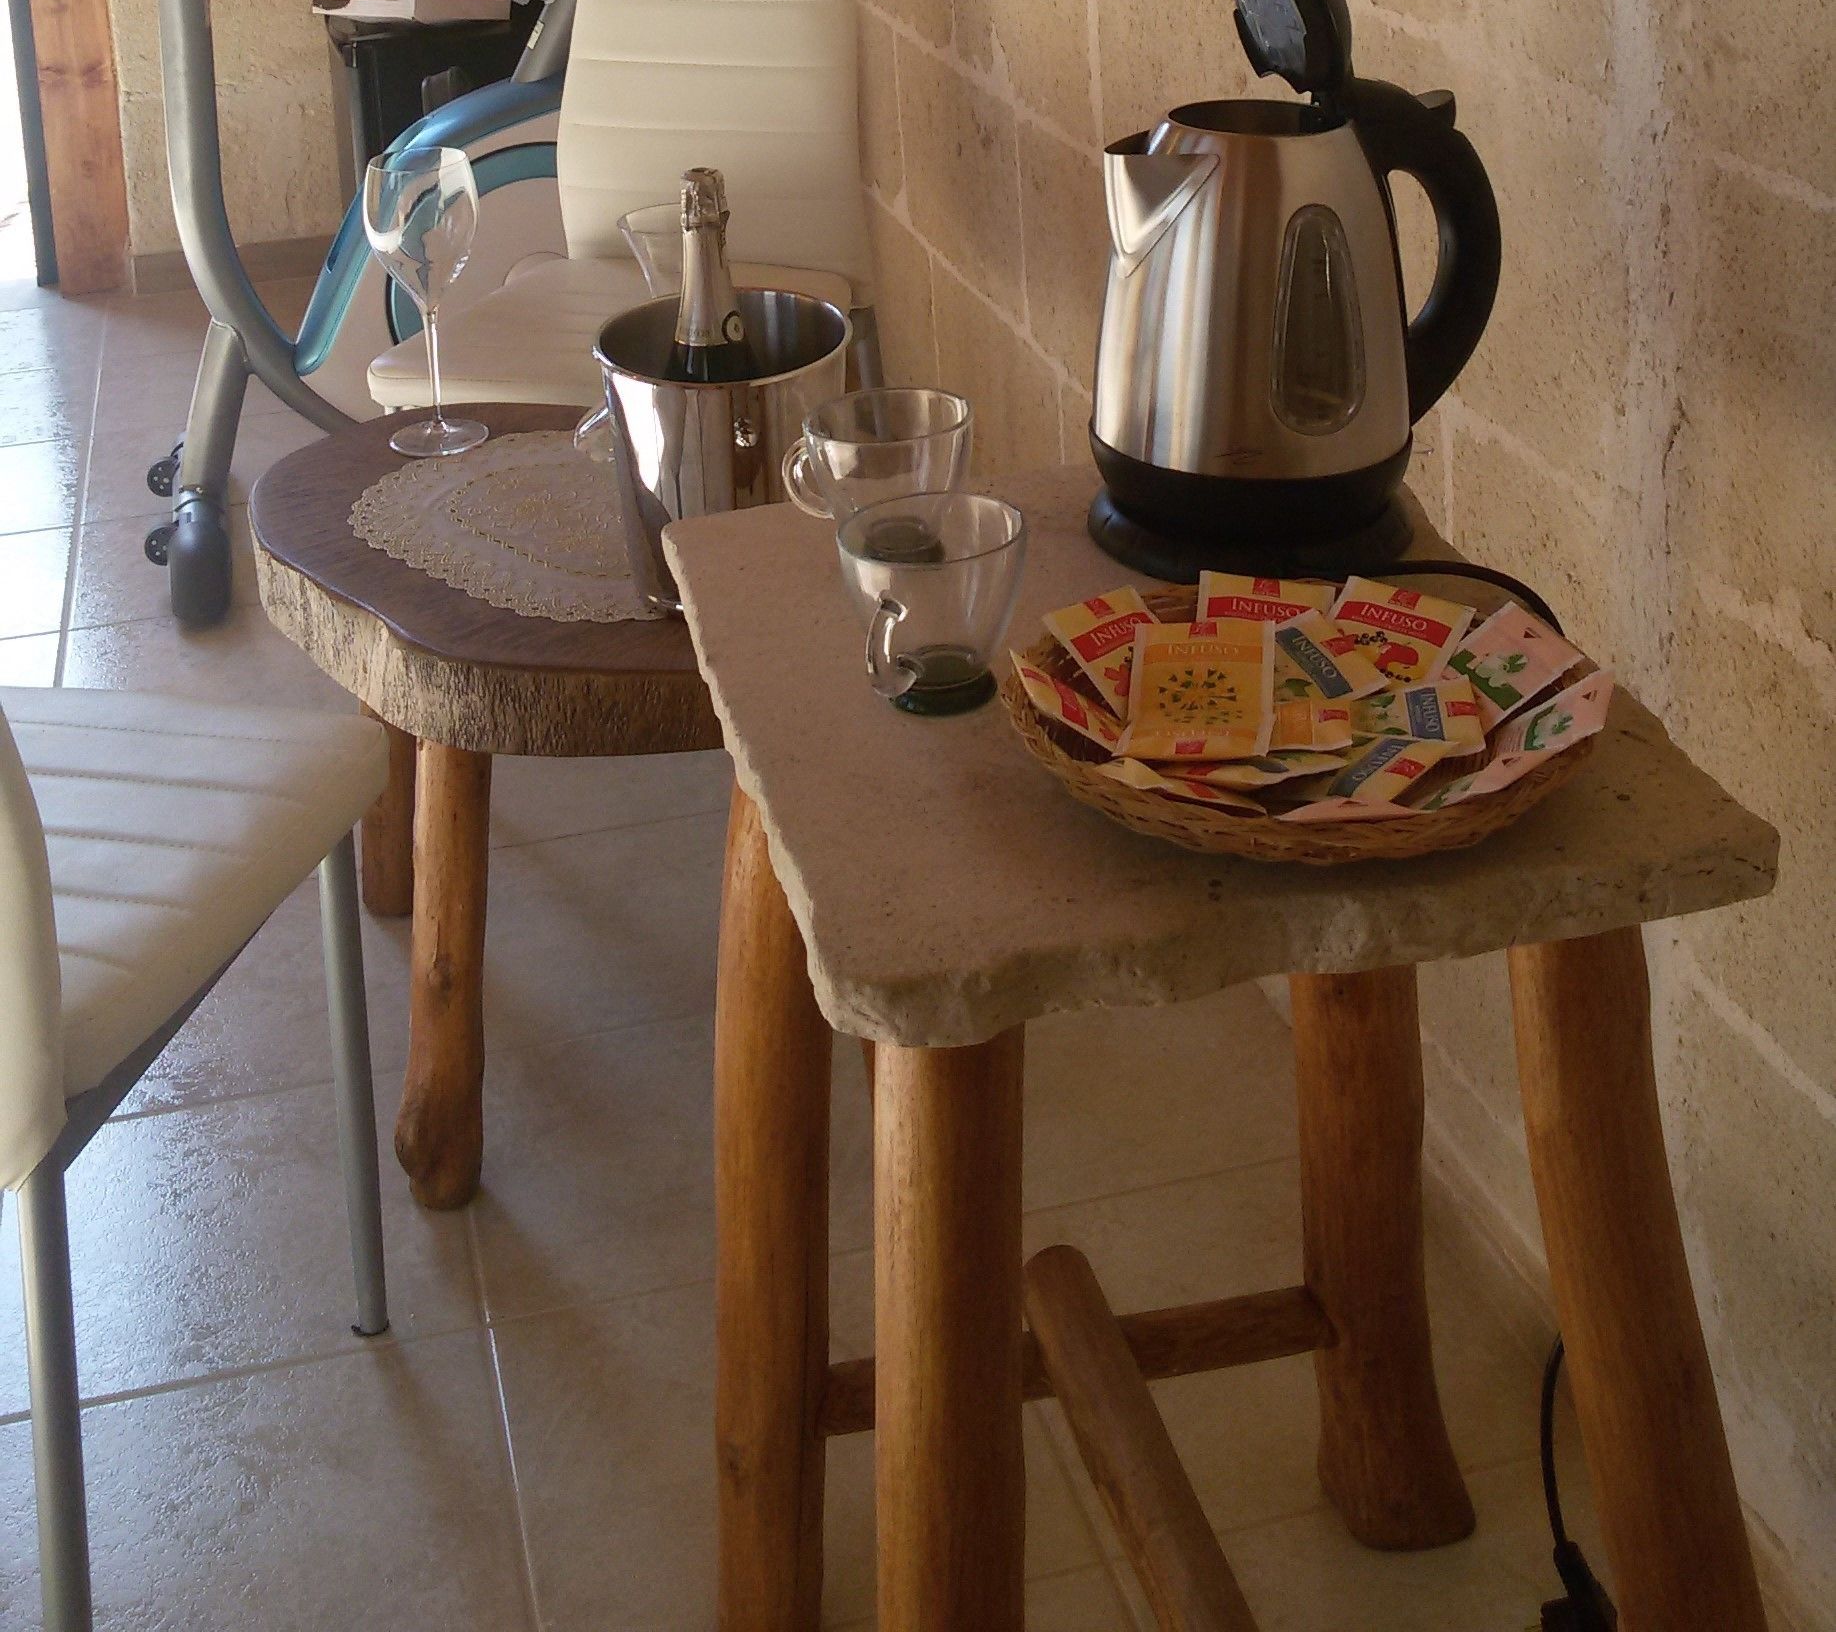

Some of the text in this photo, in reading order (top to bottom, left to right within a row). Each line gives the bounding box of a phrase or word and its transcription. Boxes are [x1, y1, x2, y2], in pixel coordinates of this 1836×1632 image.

[1232, 596, 1300, 617] INFUSO
[1361, 604, 1428, 632] INFUSO
[1292, 635, 1338, 679] INFUSO
[1421, 693, 1440, 732] INFUSO
